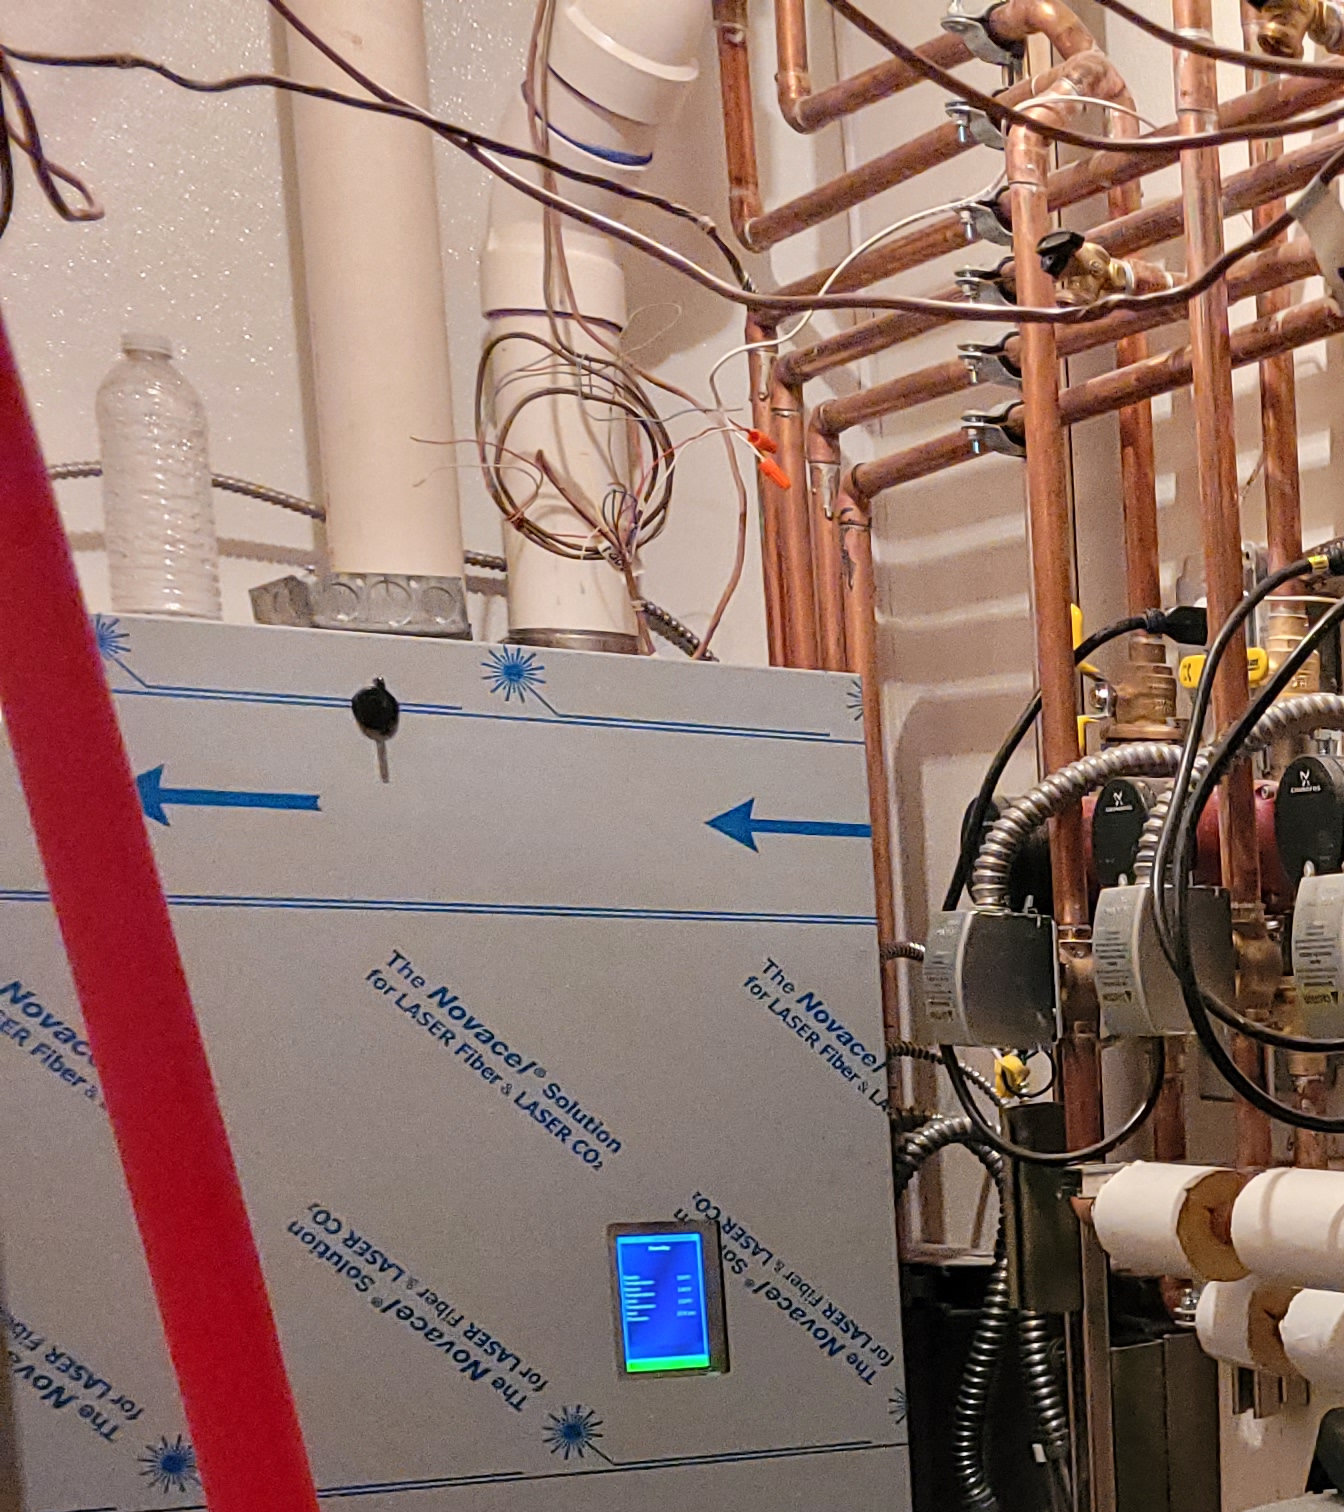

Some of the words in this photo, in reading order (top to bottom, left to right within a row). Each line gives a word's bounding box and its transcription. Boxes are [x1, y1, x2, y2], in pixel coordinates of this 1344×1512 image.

[762, 958, 795, 994] The
[387, 950, 425, 988] The
[543, 1082, 621, 1154] Solution
[743, 976, 771, 1000] for
[767, 998, 821, 1049] LASER
[819, 1044, 861, 1082] Fiber
[857, 1080, 869, 1094] &
[31, 1043, 87, 1086] Fiber
[366, 969, 397, 996] for
[394, 993, 456, 1047] LASER
[454, 1042, 503, 1084] Fiber
[501, 1083, 514, 1097] &
[513, 1091, 572, 1143] LASER
[287, 1220, 376, 1293] Solution
[342, 1229, 405, 1282] LASER
[721, 1217, 773, 1267] LASER
[773, 1260, 785, 1273] &
[416, 1288, 465, 1328] Fiber
[783, 1271, 824, 1306] Fiber
[822, 1301, 873, 1348] LASER
[463, 1322, 522, 1373] LASER
[870, 1344, 895, 1367] for
[45, 1345, 112, 1399] LASER
[519, 1367, 549, 1392] for
[846, 1352, 878, 1386] The
[110, 1395, 145, 1420] for
[491, 1376, 529, 1412] The
[78, 1404, 120, 1443] The
